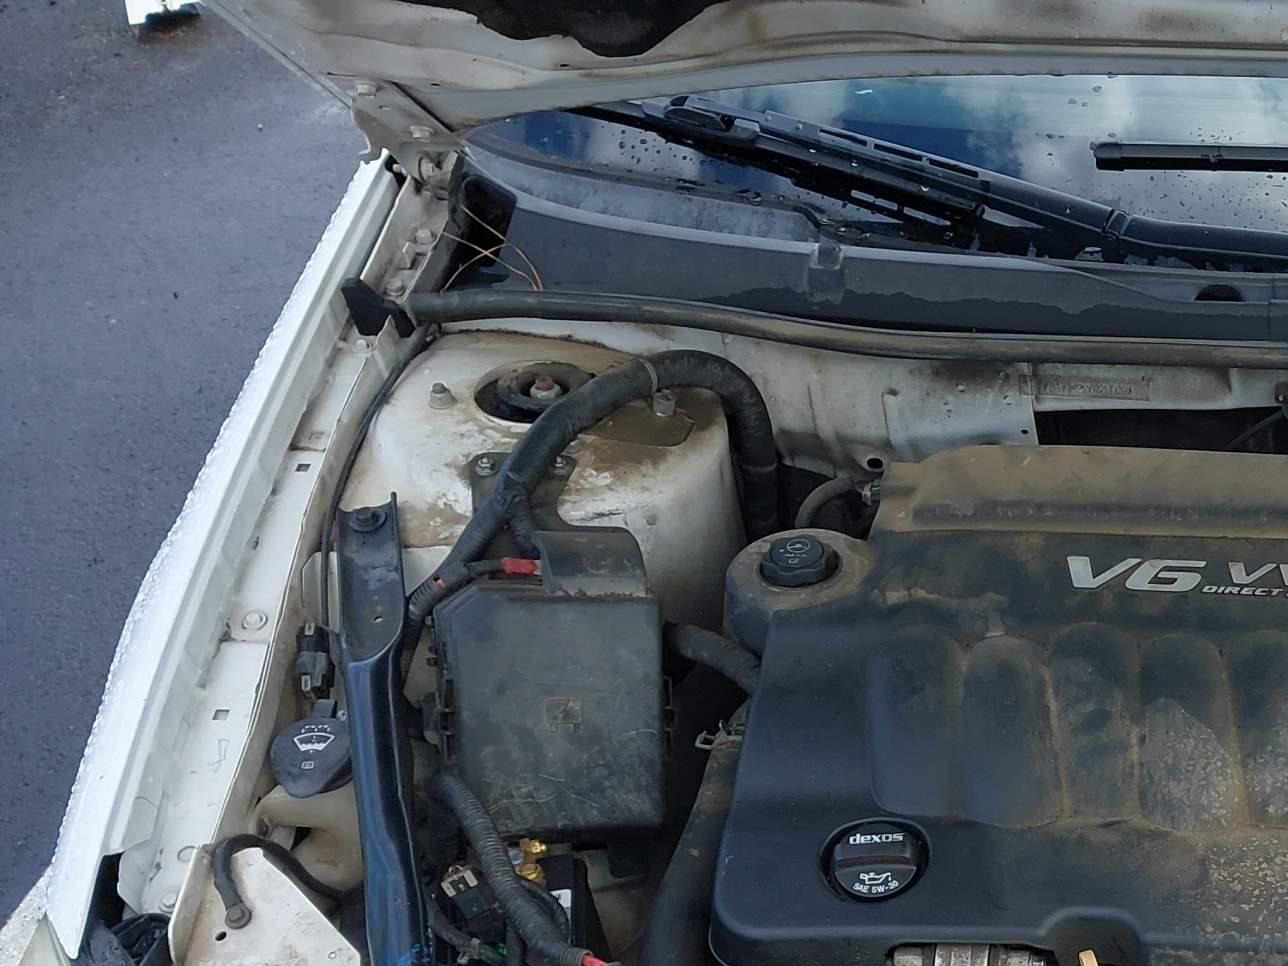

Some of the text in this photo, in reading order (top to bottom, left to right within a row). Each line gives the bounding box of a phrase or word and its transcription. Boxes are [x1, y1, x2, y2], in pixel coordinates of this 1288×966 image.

[1067, 556, 1207, 592] V6
[1202, 585, 1283, 598] DIRECT
[849, 833, 905, 845] dexos
[852, 880, 899, 894] SAE 5W-30
